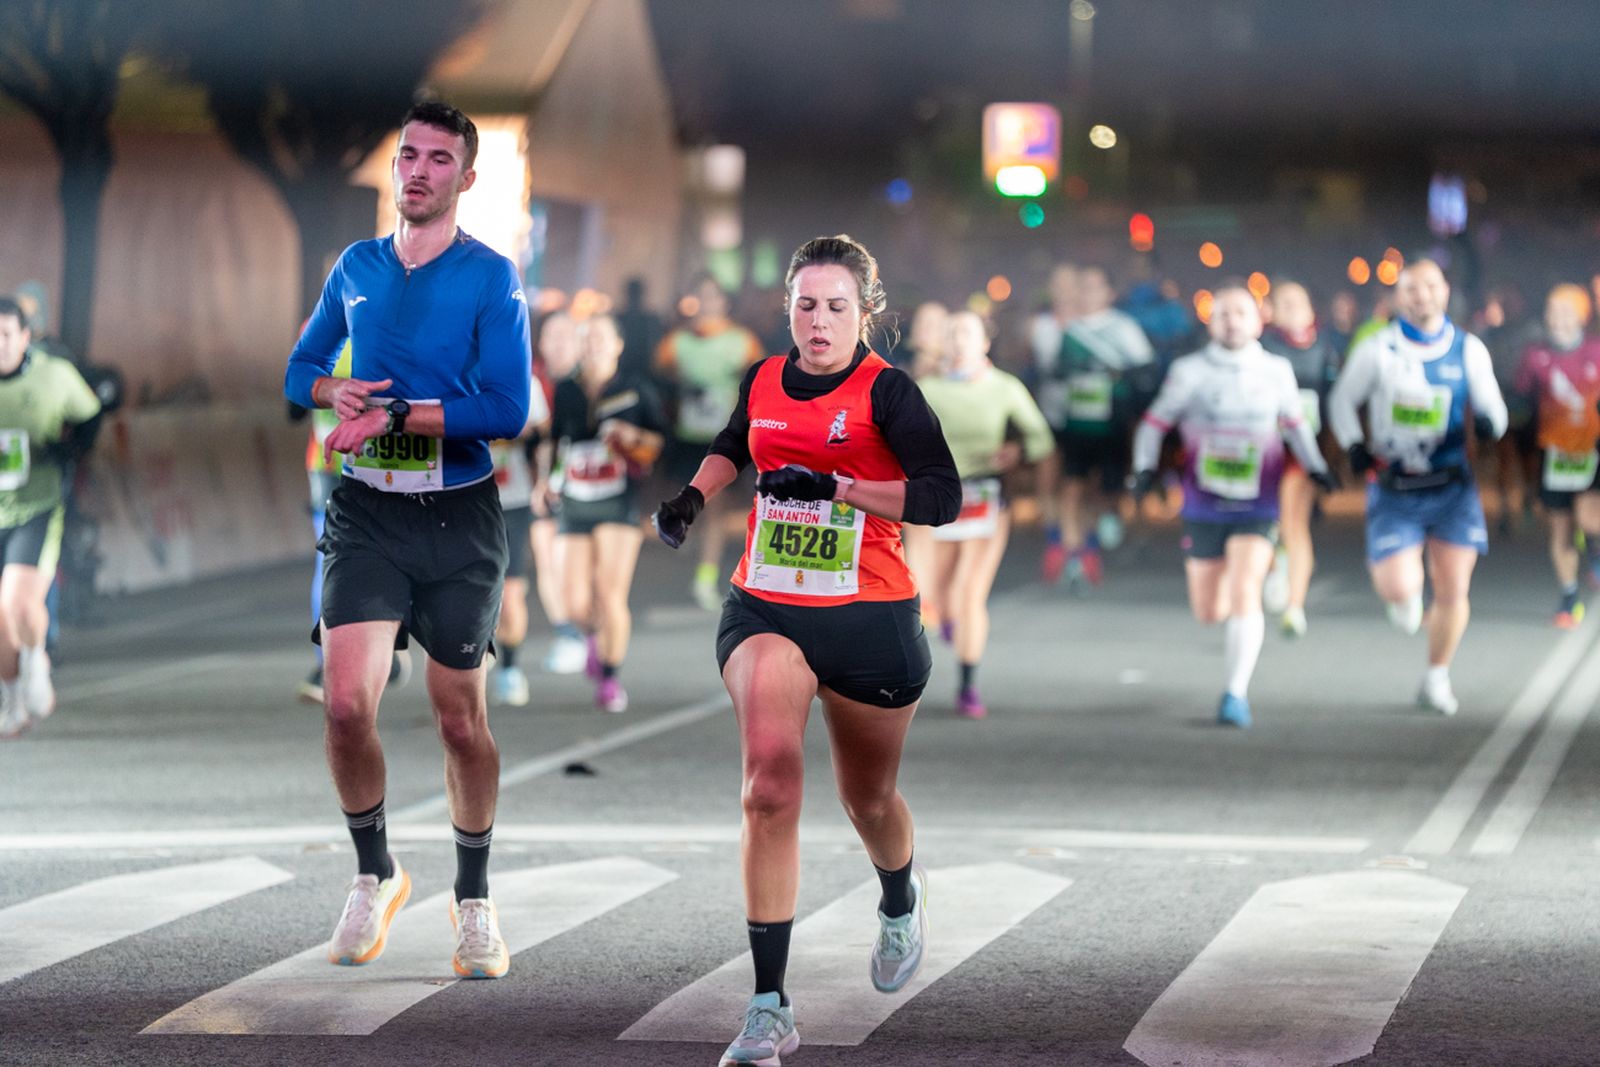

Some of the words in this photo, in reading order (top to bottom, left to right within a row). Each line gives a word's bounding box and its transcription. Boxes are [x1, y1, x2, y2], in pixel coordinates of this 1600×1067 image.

[777, 498, 806, 510] NOCHE
[808, 500, 822, 511] DE
[767, 508, 784, 520] SAN
[785, 509, 820, 524] ANTÓN
[769, 523, 838, 560] 4528
